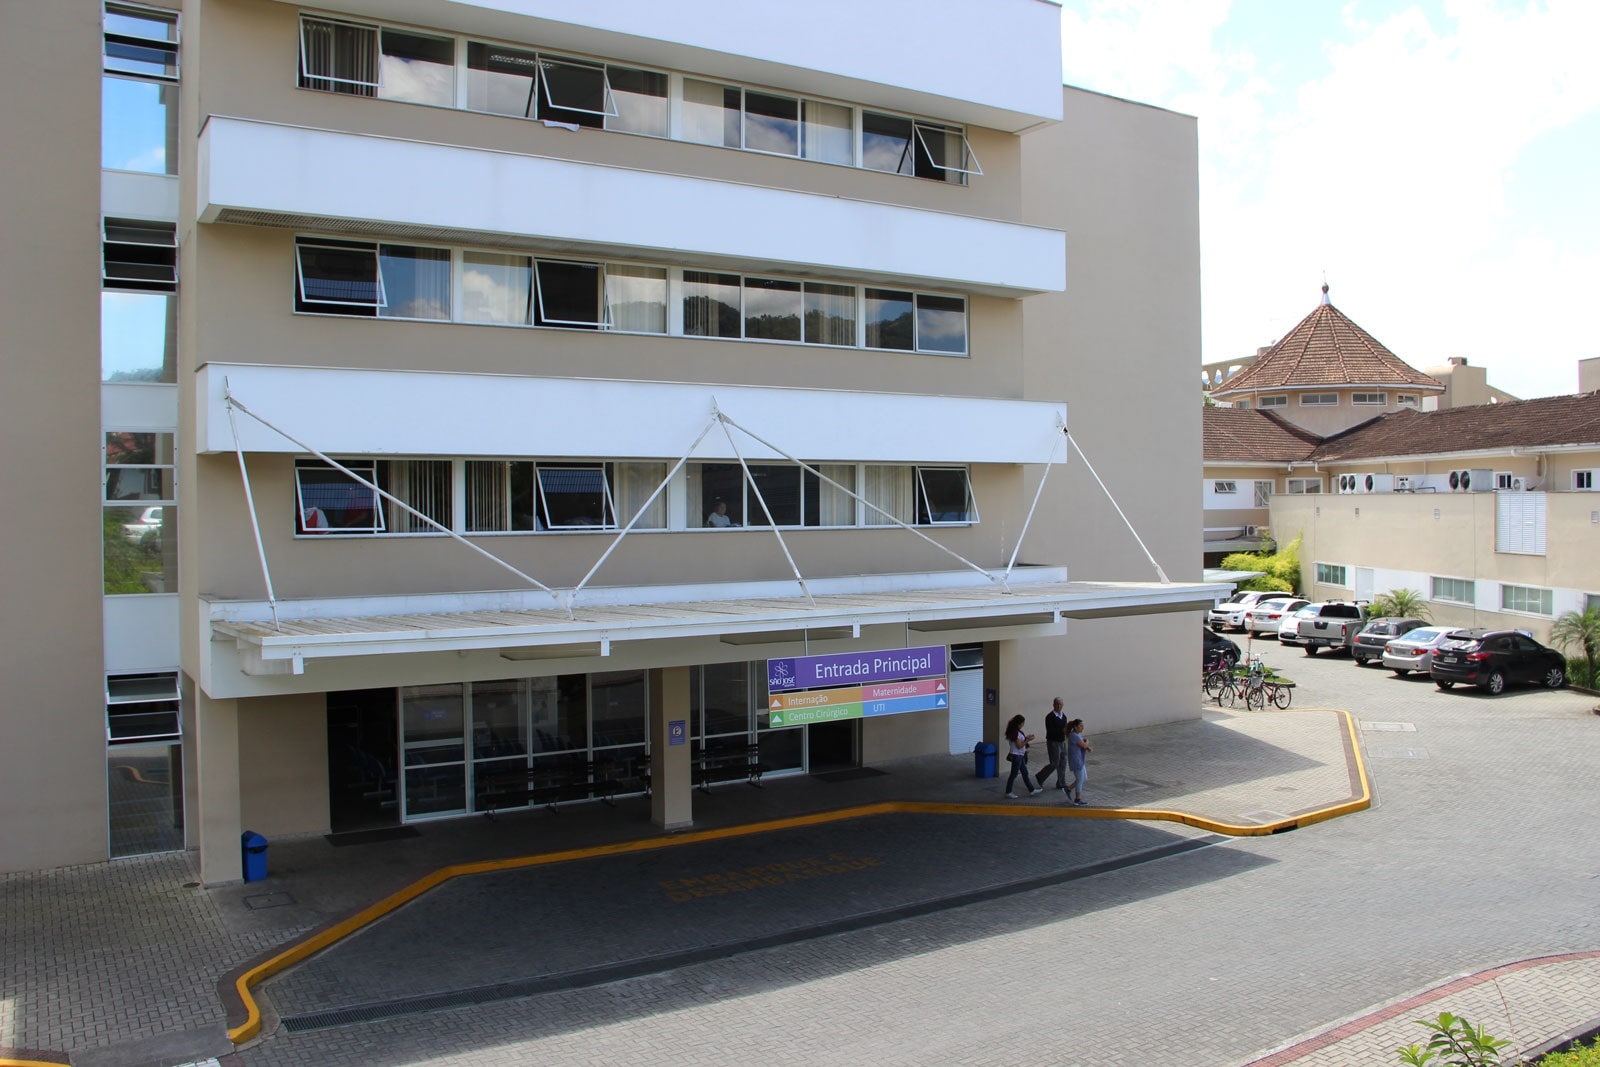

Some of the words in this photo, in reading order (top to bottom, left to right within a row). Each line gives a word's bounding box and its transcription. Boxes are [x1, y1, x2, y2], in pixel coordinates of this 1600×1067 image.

[815, 659, 870, 679] Entrada
[874, 653, 931, 673] Principal
[872, 685, 917, 697] Maternidade
[788, 694, 829, 706] Internação
[873, 703, 886, 712] UTI
[788, 711, 815, 721] Centro
[816, 707, 849, 719] Cirúrgico
